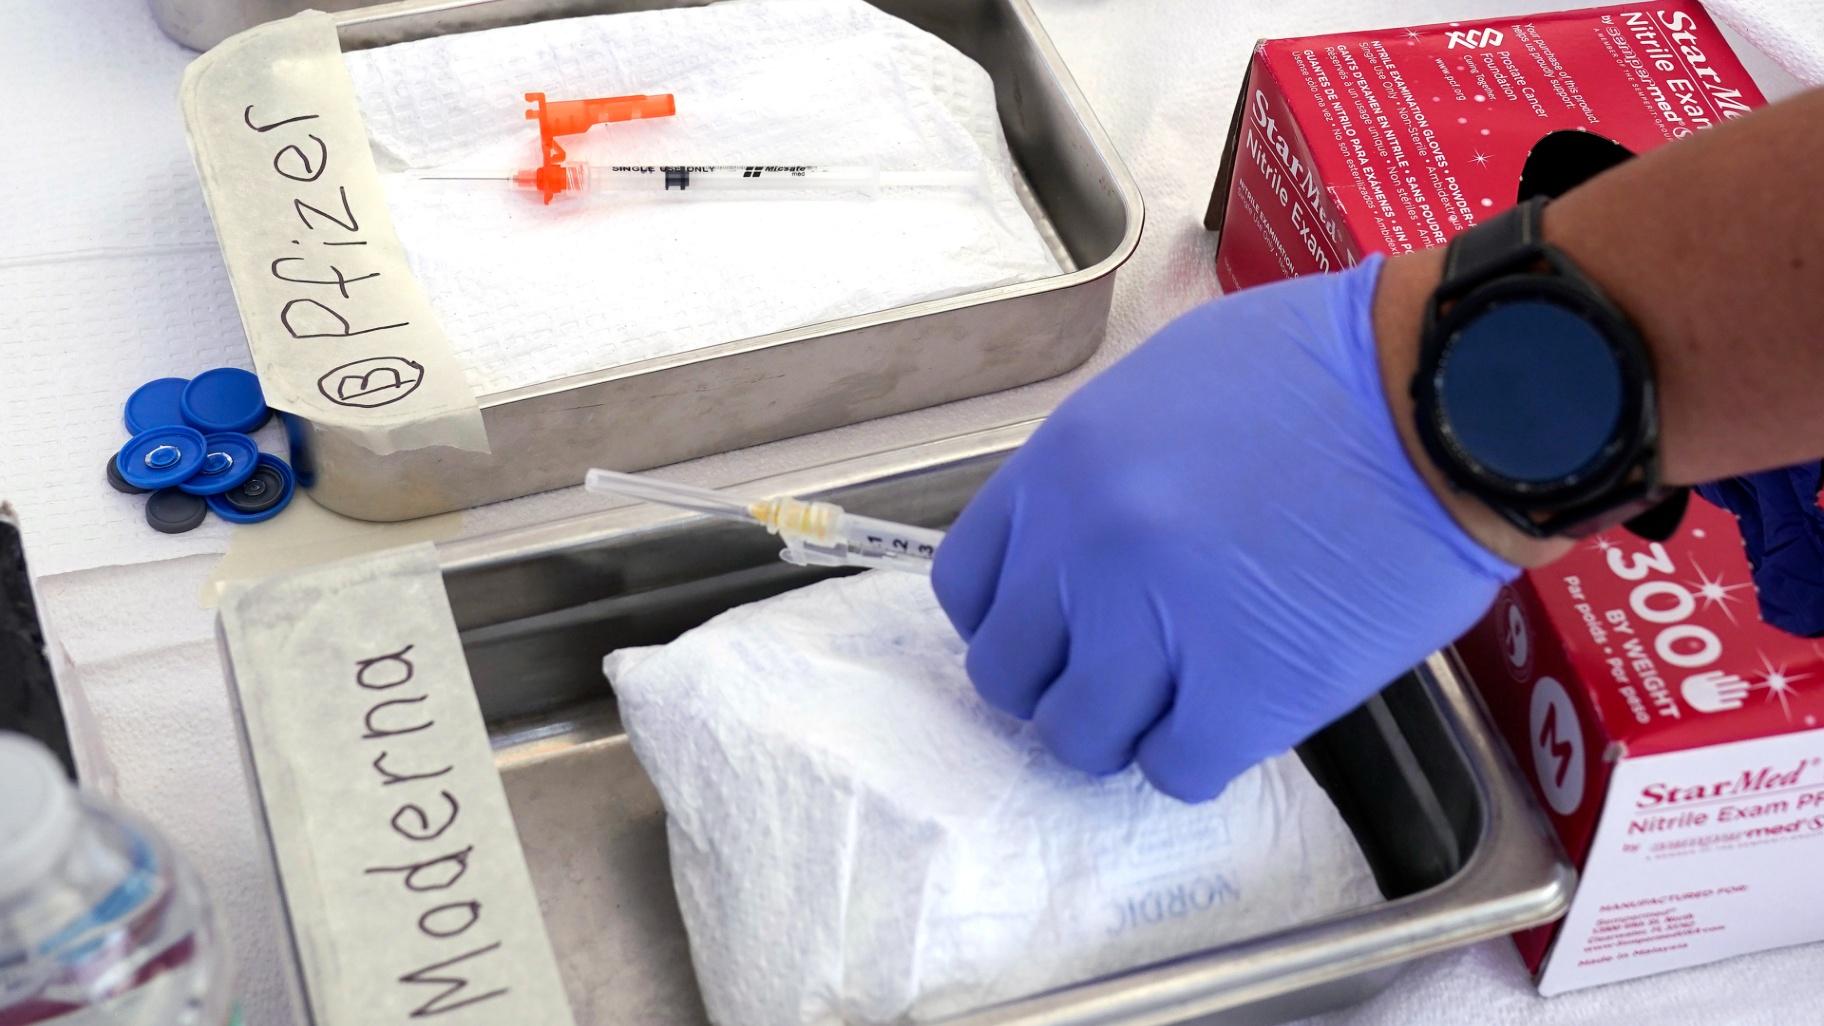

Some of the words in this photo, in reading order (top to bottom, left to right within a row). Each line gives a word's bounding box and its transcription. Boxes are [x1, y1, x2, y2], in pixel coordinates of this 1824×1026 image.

[1511, 24, 1529, 45] helps
[1524, 23, 1539, 39] Your
[1601, 15, 1614, 25] by
[1525, 43, 1535, 54] us
[1533, 38, 1562, 71] purchase
[1620, 12, 1675, 72] Nitrile
[1304, 50, 1330, 88] GUANTES
[1434, 57, 1467, 101] www.pcf.org
[1463, 54, 1479, 75] Curing
[1480, 52, 1518, 102] Foundation
[1529, 51, 1555, 78] proudly
[1558, 71, 1571, 81] of
[1623, 69, 1635, 82] THE
[1325, 87, 1338, 101] DE
[1497, 50, 1527, 87] Prostate
[1521, 87, 1549, 119] Cancer
[1564, 79, 1578, 95] this
[1331, 101, 1356, 137] NITRILO
[1371, 40, 1396, 71] NITRILE
[1389, 69, 1429, 128] EXAMINATION
[1423, 129, 1448, 168] GLOVES
[1571, 94, 1599, 124] product
[1314, 93, 1326, 108] una
[1323, 111, 1334, 122] vez
[1332, 128, 1341, 141] No
[1338, 142, 1351, 157] son
[1346, 159, 1375, 209] esterilizados
[1337, 45, 1359, 75] GANTS
[1353, 71, 1383, 115] D'EXAMEN
[1376, 115, 1390, 129] EN
[1383, 129, 1409, 168] NITRILE
[1405, 176, 1425, 203] SANS
[1419, 204, 1447, 245] POUDRE
[1348, 86, 1358, 99] un
[1354, 100, 1372, 125] usage
[1368, 126, 1388, 157] unique
[1387, 166, 1401, 187] Non
[1397, 188, 1418, 221] stériles
[1350, 137, 1369, 165] PARA
[1359, 42, 1377, 65] Single
[1373, 65, 1386, 80] Use
[1382, 81, 1398, 100] Only
[1399, 107, 1427, 157] Non-Sterile
[1426, 166, 1463, 231] Ambidextrous
[1246, 129, 1289, 207] Nitrile
[1292, 201, 1330, 276] Exam
[1362, 166, 1395, 218] EXÁMENES
[244, 104, 410, 340] Pfizer
[1392, 225, 1408, 247] SIN
[1260, 211, 1294, 273] EXAMINATION
[867, 535, 882, 544] 1
[892, 538, 908, 549] 2
[1563, 575, 1586, 602] Par
[1606, 542, 1722, 668] 300
[1574, 601, 1608, 645] poids
[1605, 608, 1636, 635] BY
[1622, 638, 1681, 719] WEIGHT
[1606, 657, 1630, 685] Por
[1618, 685, 1651, 724] peso
[355, 643, 510, 1021] Moderna
[1627, 813, 1708, 836] Nitrile
[1717, 801, 1789, 824] Exam
[1106, 873, 1240, 936] NORDIC
